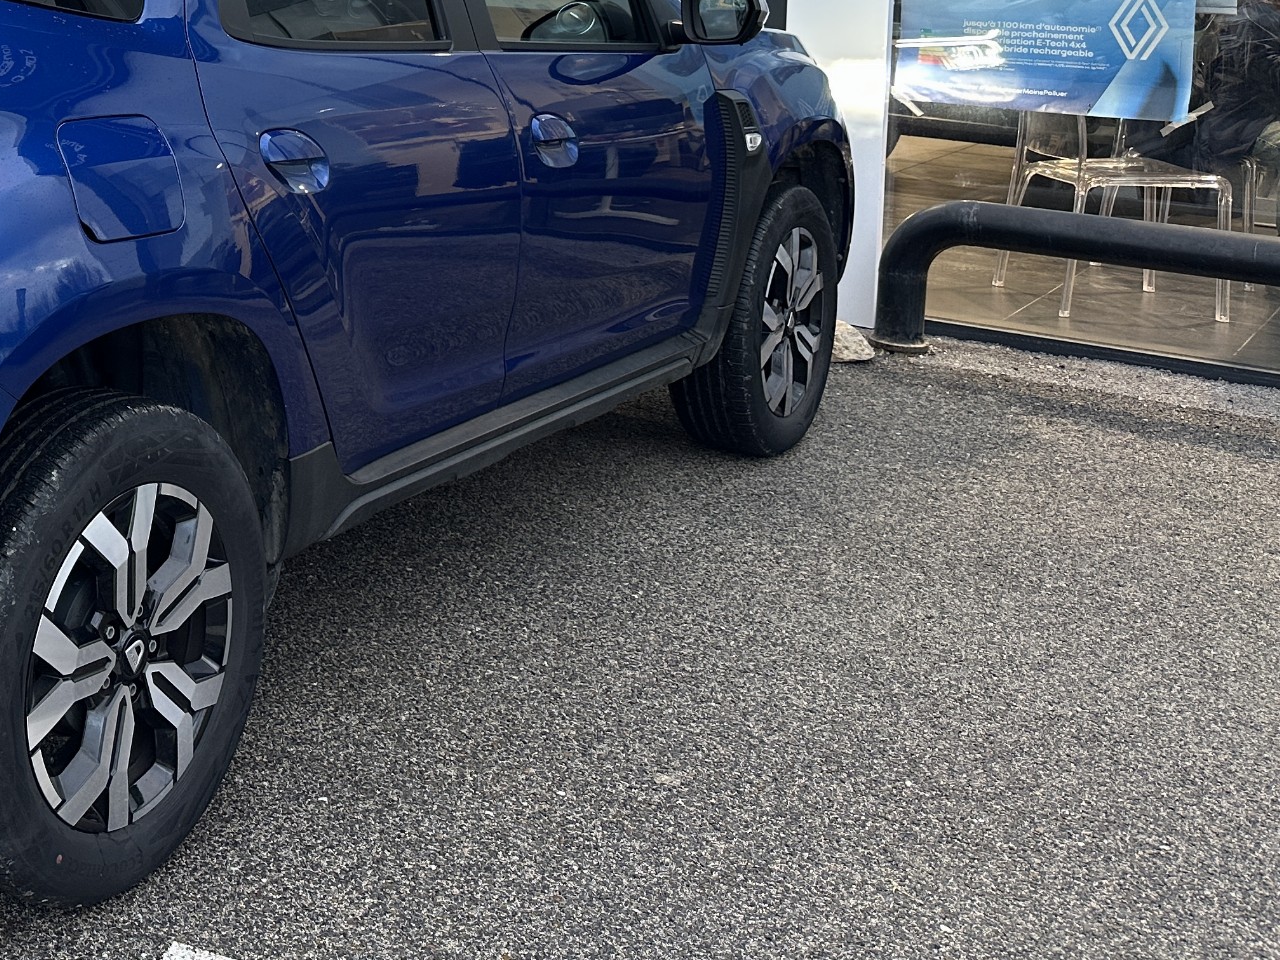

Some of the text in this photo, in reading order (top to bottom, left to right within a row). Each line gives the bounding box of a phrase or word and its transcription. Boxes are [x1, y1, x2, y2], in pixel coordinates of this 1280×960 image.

[1019, 21, 1035, 30] km
[1011, 30, 1084, 41] prochainement
[1036, 38, 1068, 47] E-Tech
[1069, 40, 1087, 49] 4x4
[1029, 46, 1094, 58] rechargeable
